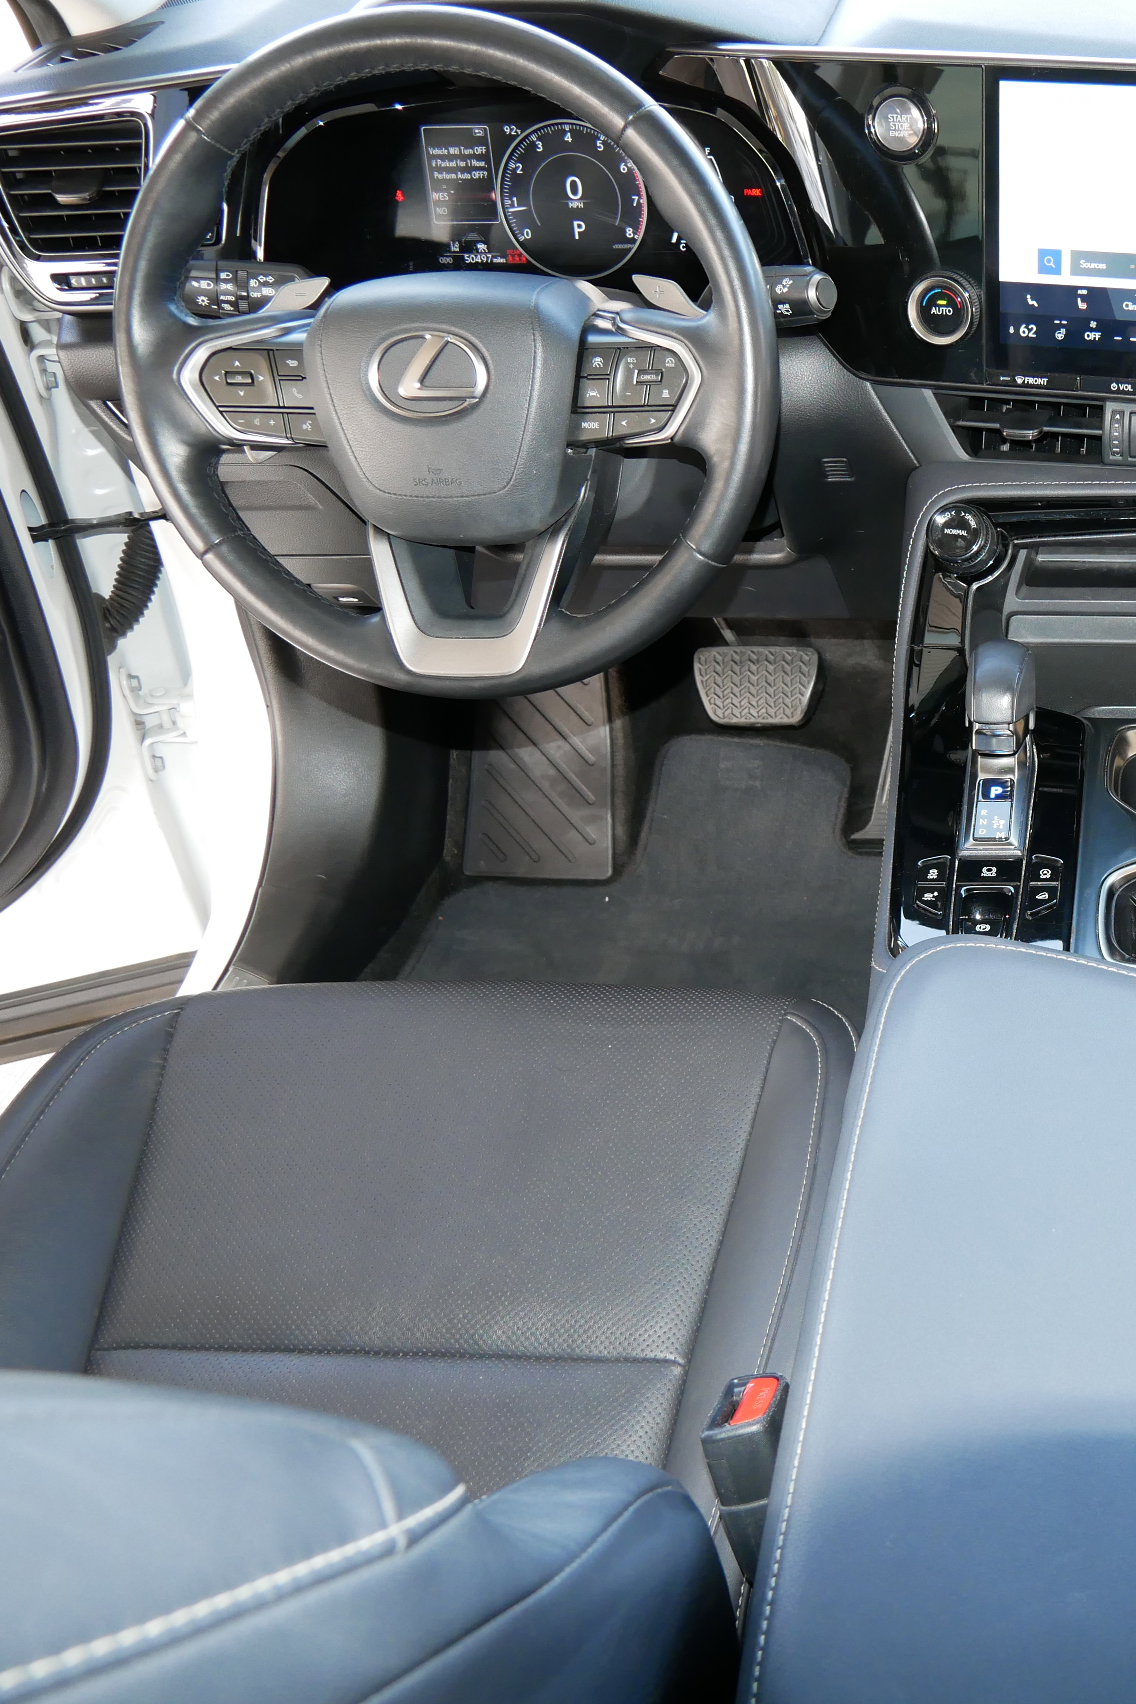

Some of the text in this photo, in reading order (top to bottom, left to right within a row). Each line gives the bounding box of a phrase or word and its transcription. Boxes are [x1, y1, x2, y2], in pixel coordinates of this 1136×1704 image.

[888, 114, 911, 122] START
[564, 132, 572, 142] 4
[428, 146, 448, 154] Vehicle
[474, 146, 486, 154] OFF
[535, 141, 543, 151] 3
[596, 140, 604, 151] 5
[515, 163, 523, 173] 2
[620, 163, 628, 173] 6
[457, 171, 471, 179] Auto
[472, 171, 487, 179] OFF?
[565, 176, 583, 200] 0
[512, 196, 518, 207] 1
[632, 196, 639, 206] 7
[523, 228, 532, 239] 0
[573, 220, 586, 240] P
[625, 227, 634, 238] 8
[464, 254, 492, 264] 50497
[1079, 259, 1107, 270] Sources
[930, 306, 953, 316] AUTO
[1019, 324, 1037, 338] 62
[1084, 331, 1101, 341] OFF
[1024, 377, 1048, 386] FRONT
[1118, 383, 1133, 392] VOL
[581, 421, 600, 429] MODE
[944, 528, 968, 536] NORMAL
[990, 786, 1003, 798] P
